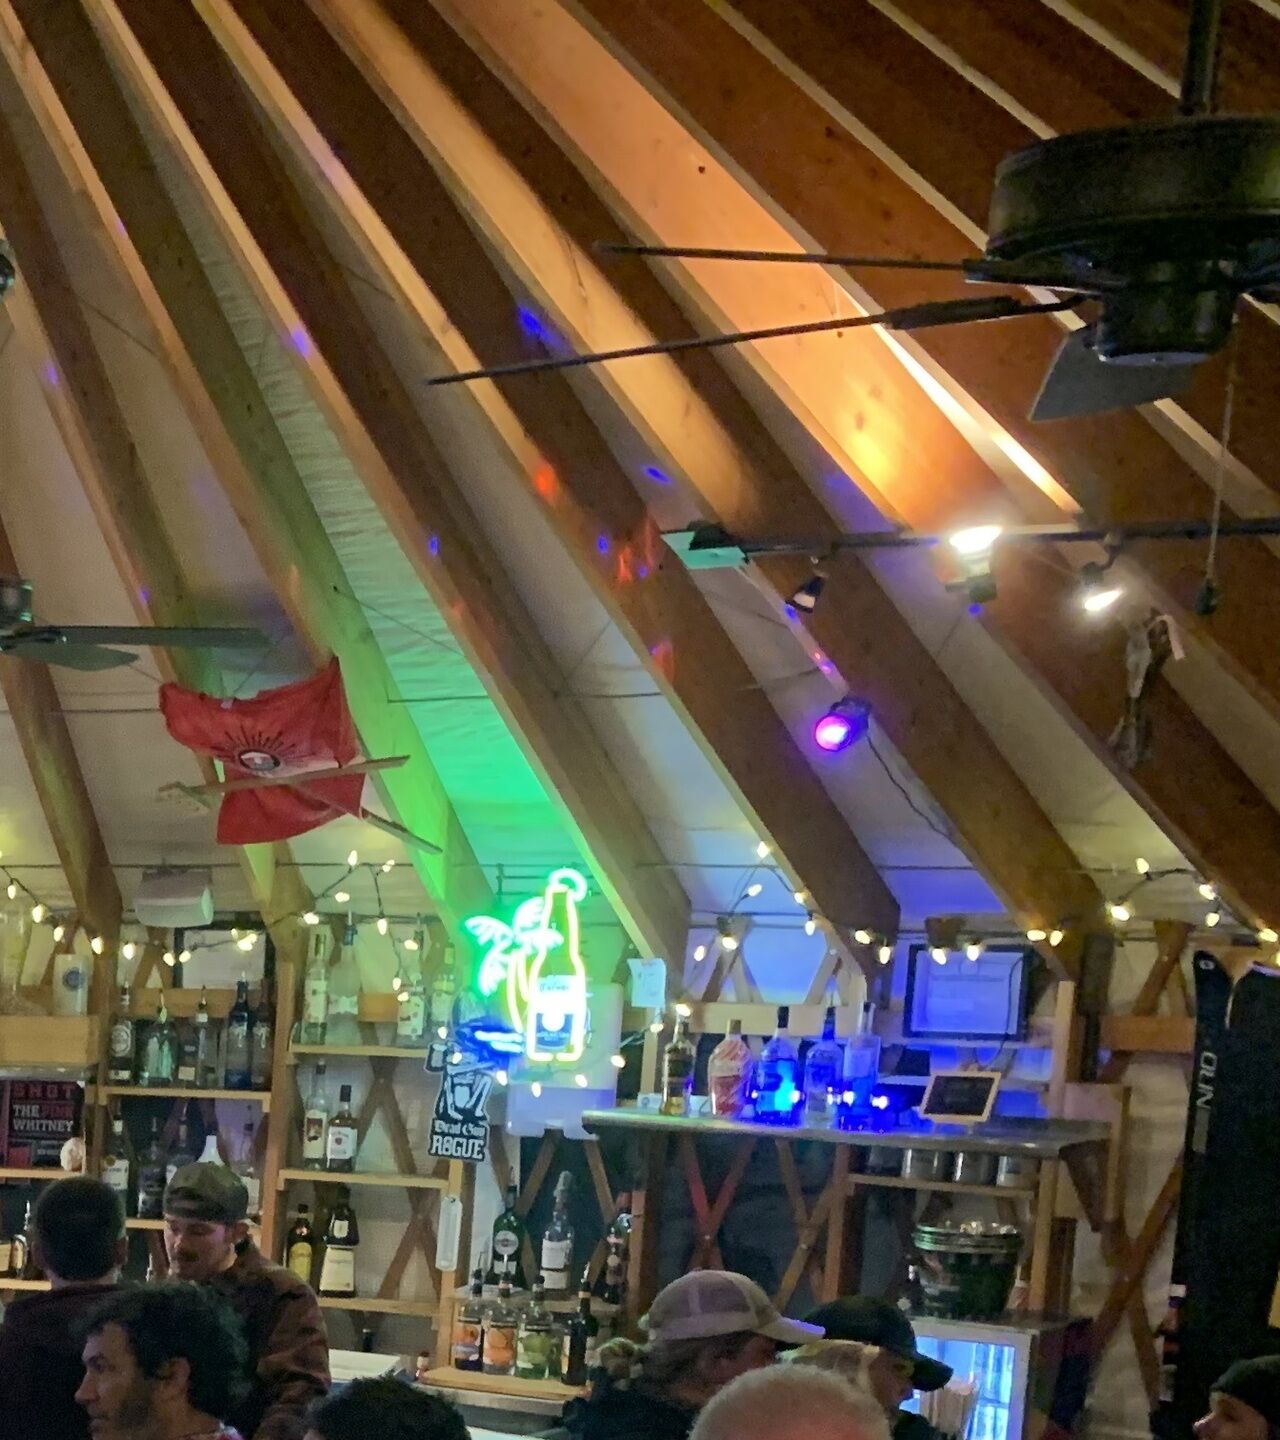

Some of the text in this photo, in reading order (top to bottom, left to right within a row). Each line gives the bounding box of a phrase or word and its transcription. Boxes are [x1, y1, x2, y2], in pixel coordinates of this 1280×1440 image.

[12, 1104, 40, 1119] THE
[12, 1118, 75, 1133] WHITNEY
[431, 1134, 485, 1160] ROGUE
